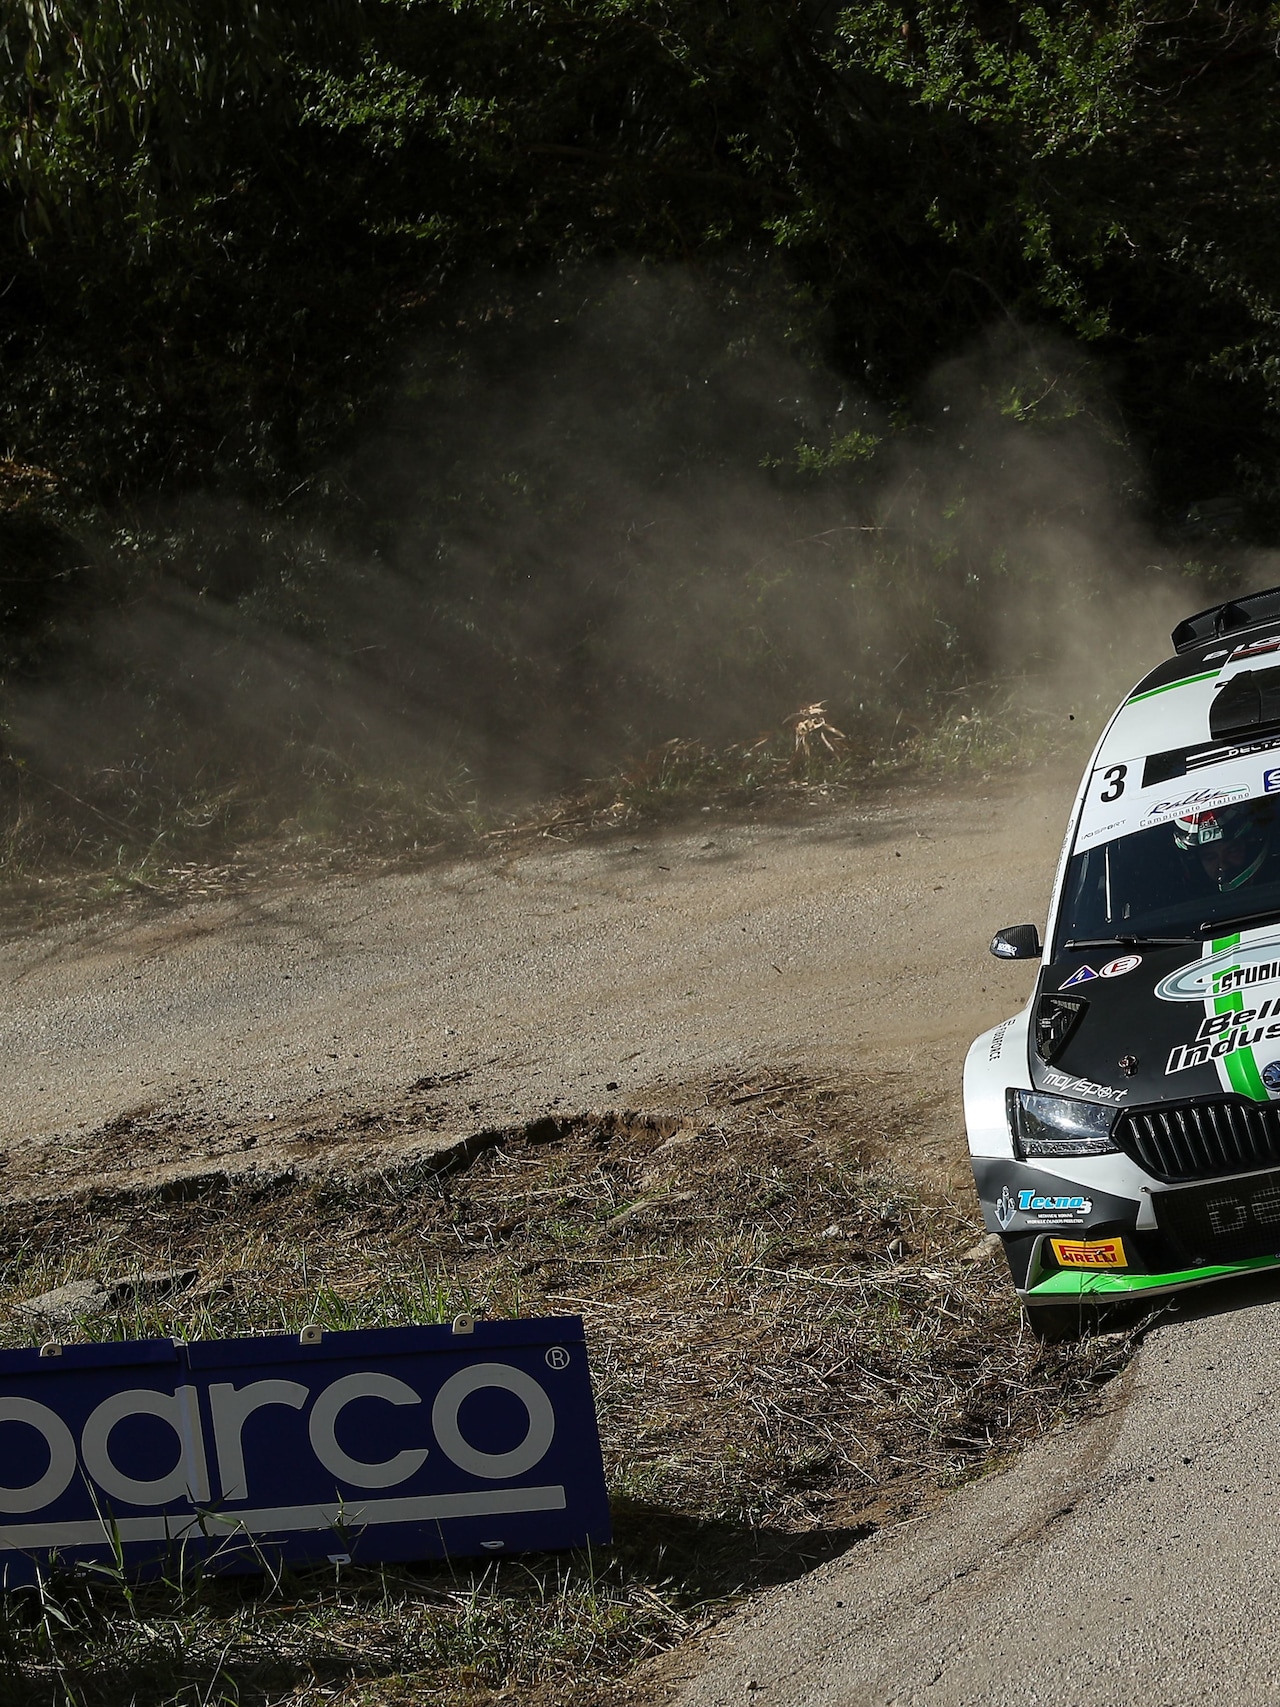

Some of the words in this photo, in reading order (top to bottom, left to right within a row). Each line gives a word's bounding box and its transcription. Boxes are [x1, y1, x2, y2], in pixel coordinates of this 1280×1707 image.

[1100, 765, 1128, 803] 3
[1139, 804, 1201, 828] Campionato
[1208, 792, 1250, 807] Italiano
[1148, 788, 1222, 817] Rally
[1058, 1245, 1118, 1263] PIRELLI
